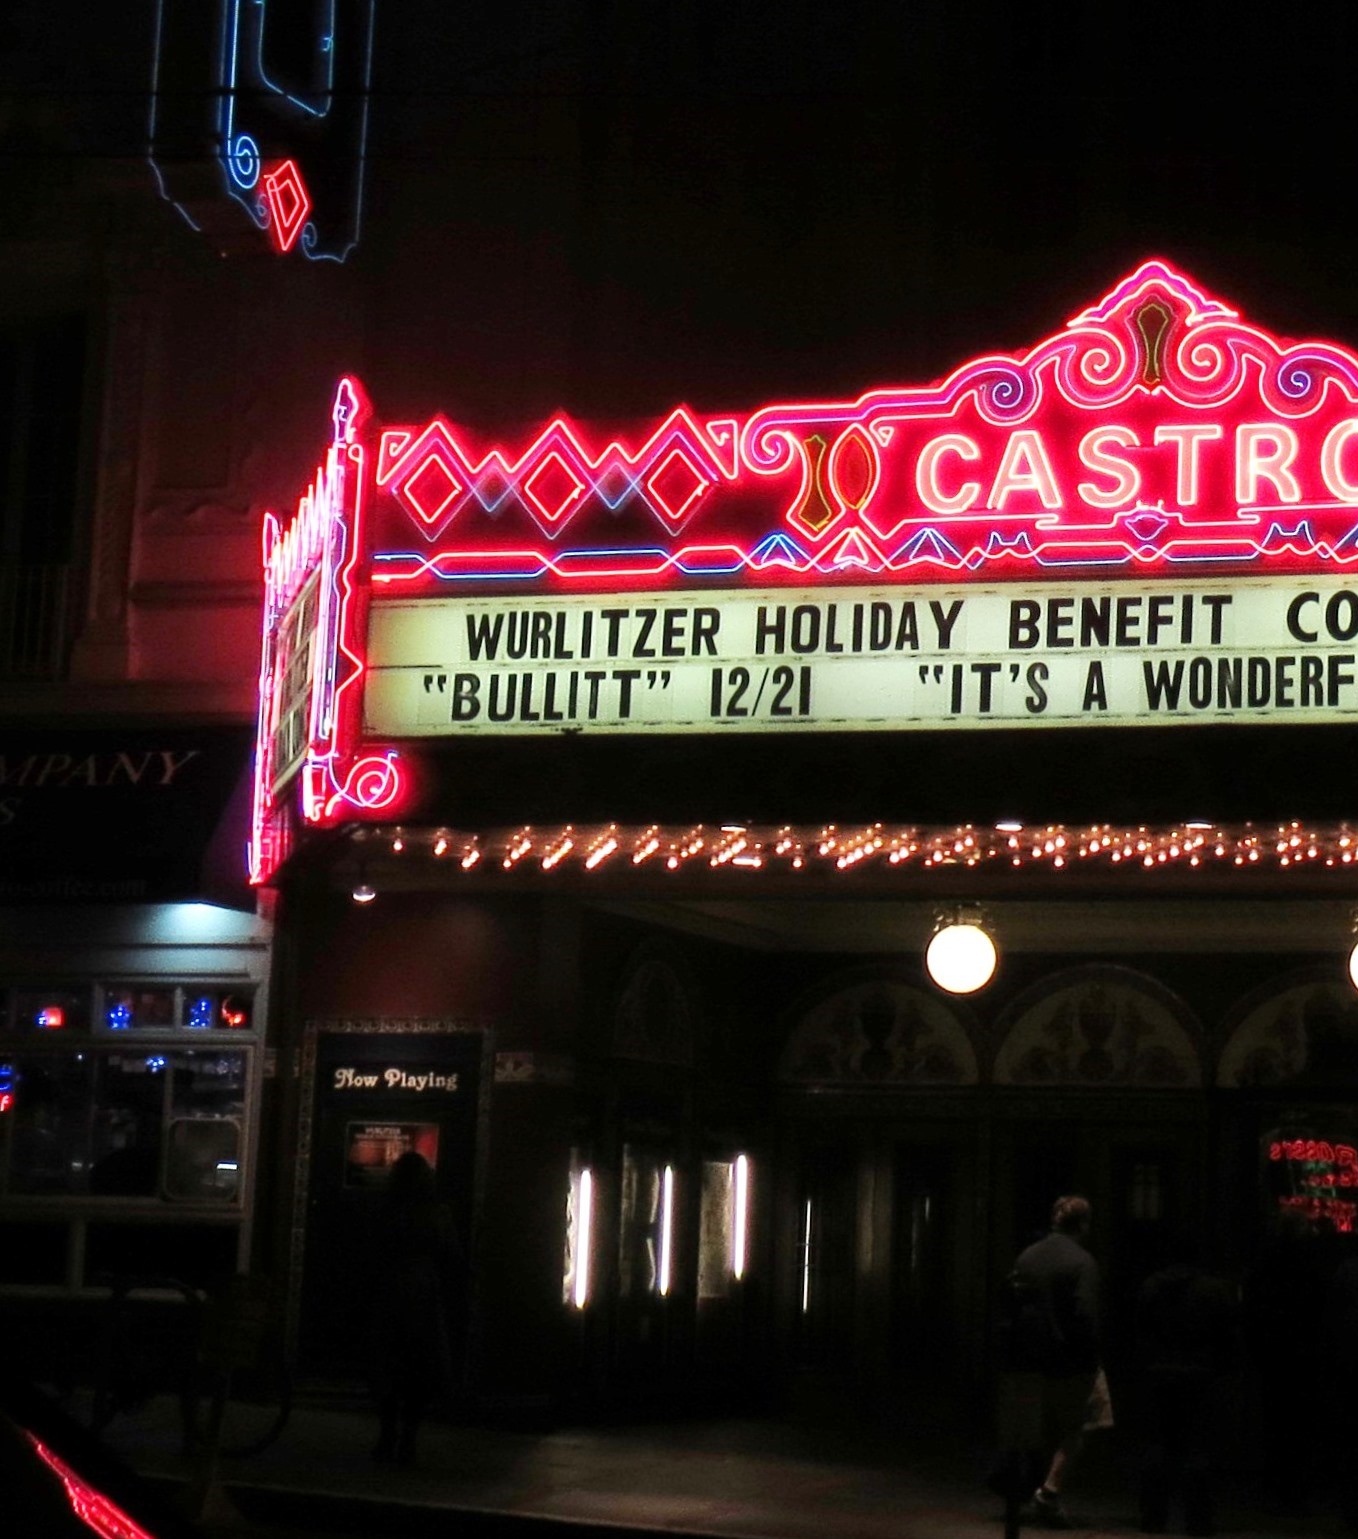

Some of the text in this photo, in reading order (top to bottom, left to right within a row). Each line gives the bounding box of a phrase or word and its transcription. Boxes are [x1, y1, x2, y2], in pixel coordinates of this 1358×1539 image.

[466, 607, 721, 661] WURLITZER
[756, 600, 964, 655] HOLIDAY
[1008, 594, 1233, 649] BENEFIT
[710, 665, 811, 717] 12/21
[1082, 660, 1108, 711] A
[334, 1066, 459, 1092] Now Playing
